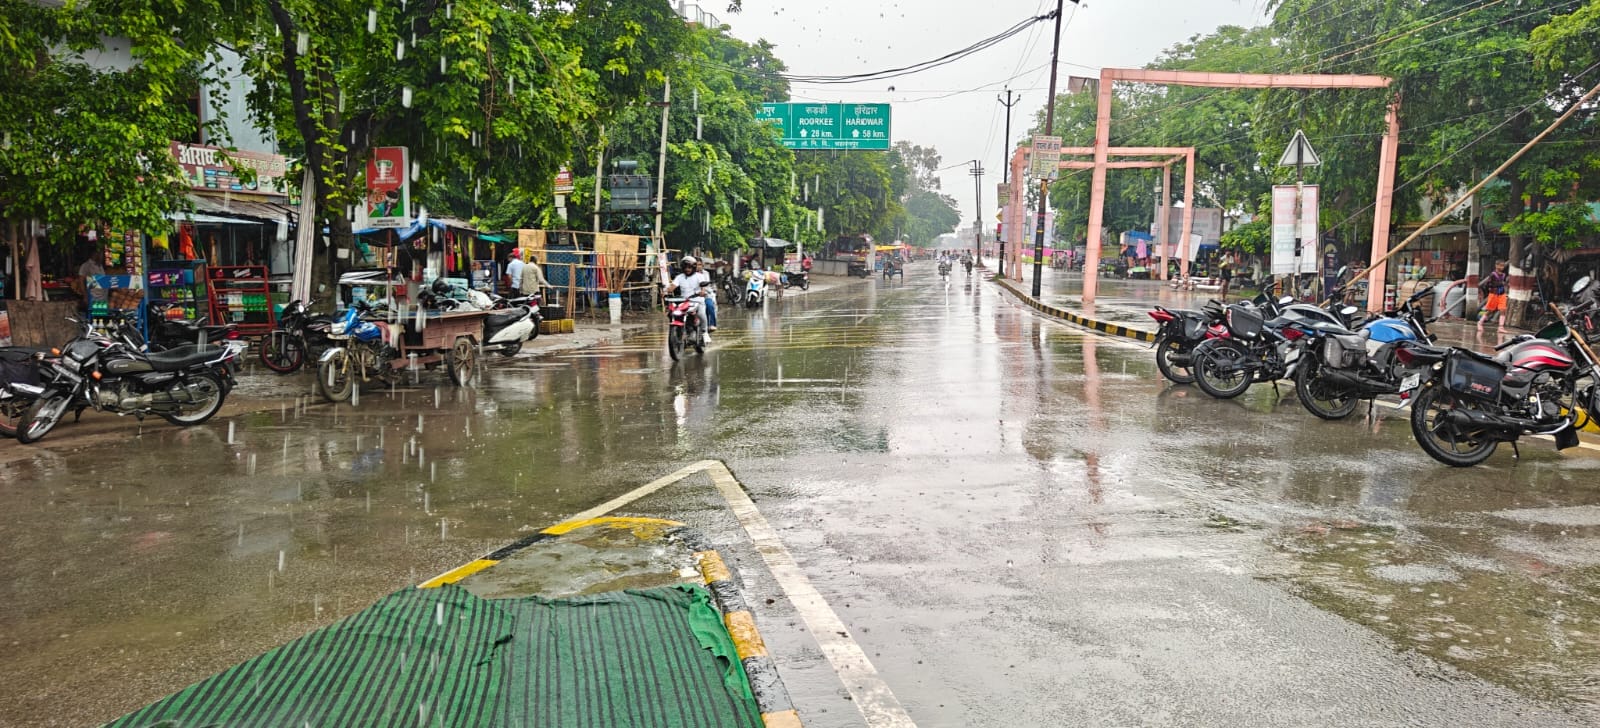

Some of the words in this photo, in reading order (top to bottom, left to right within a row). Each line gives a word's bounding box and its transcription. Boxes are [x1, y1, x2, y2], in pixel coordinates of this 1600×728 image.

[799, 117, 833, 126] ROORKEE
[845, 117, 883, 126] HARIDWAR
[811, 129, 819, 138] 28
[862, 129, 871, 138] 58
